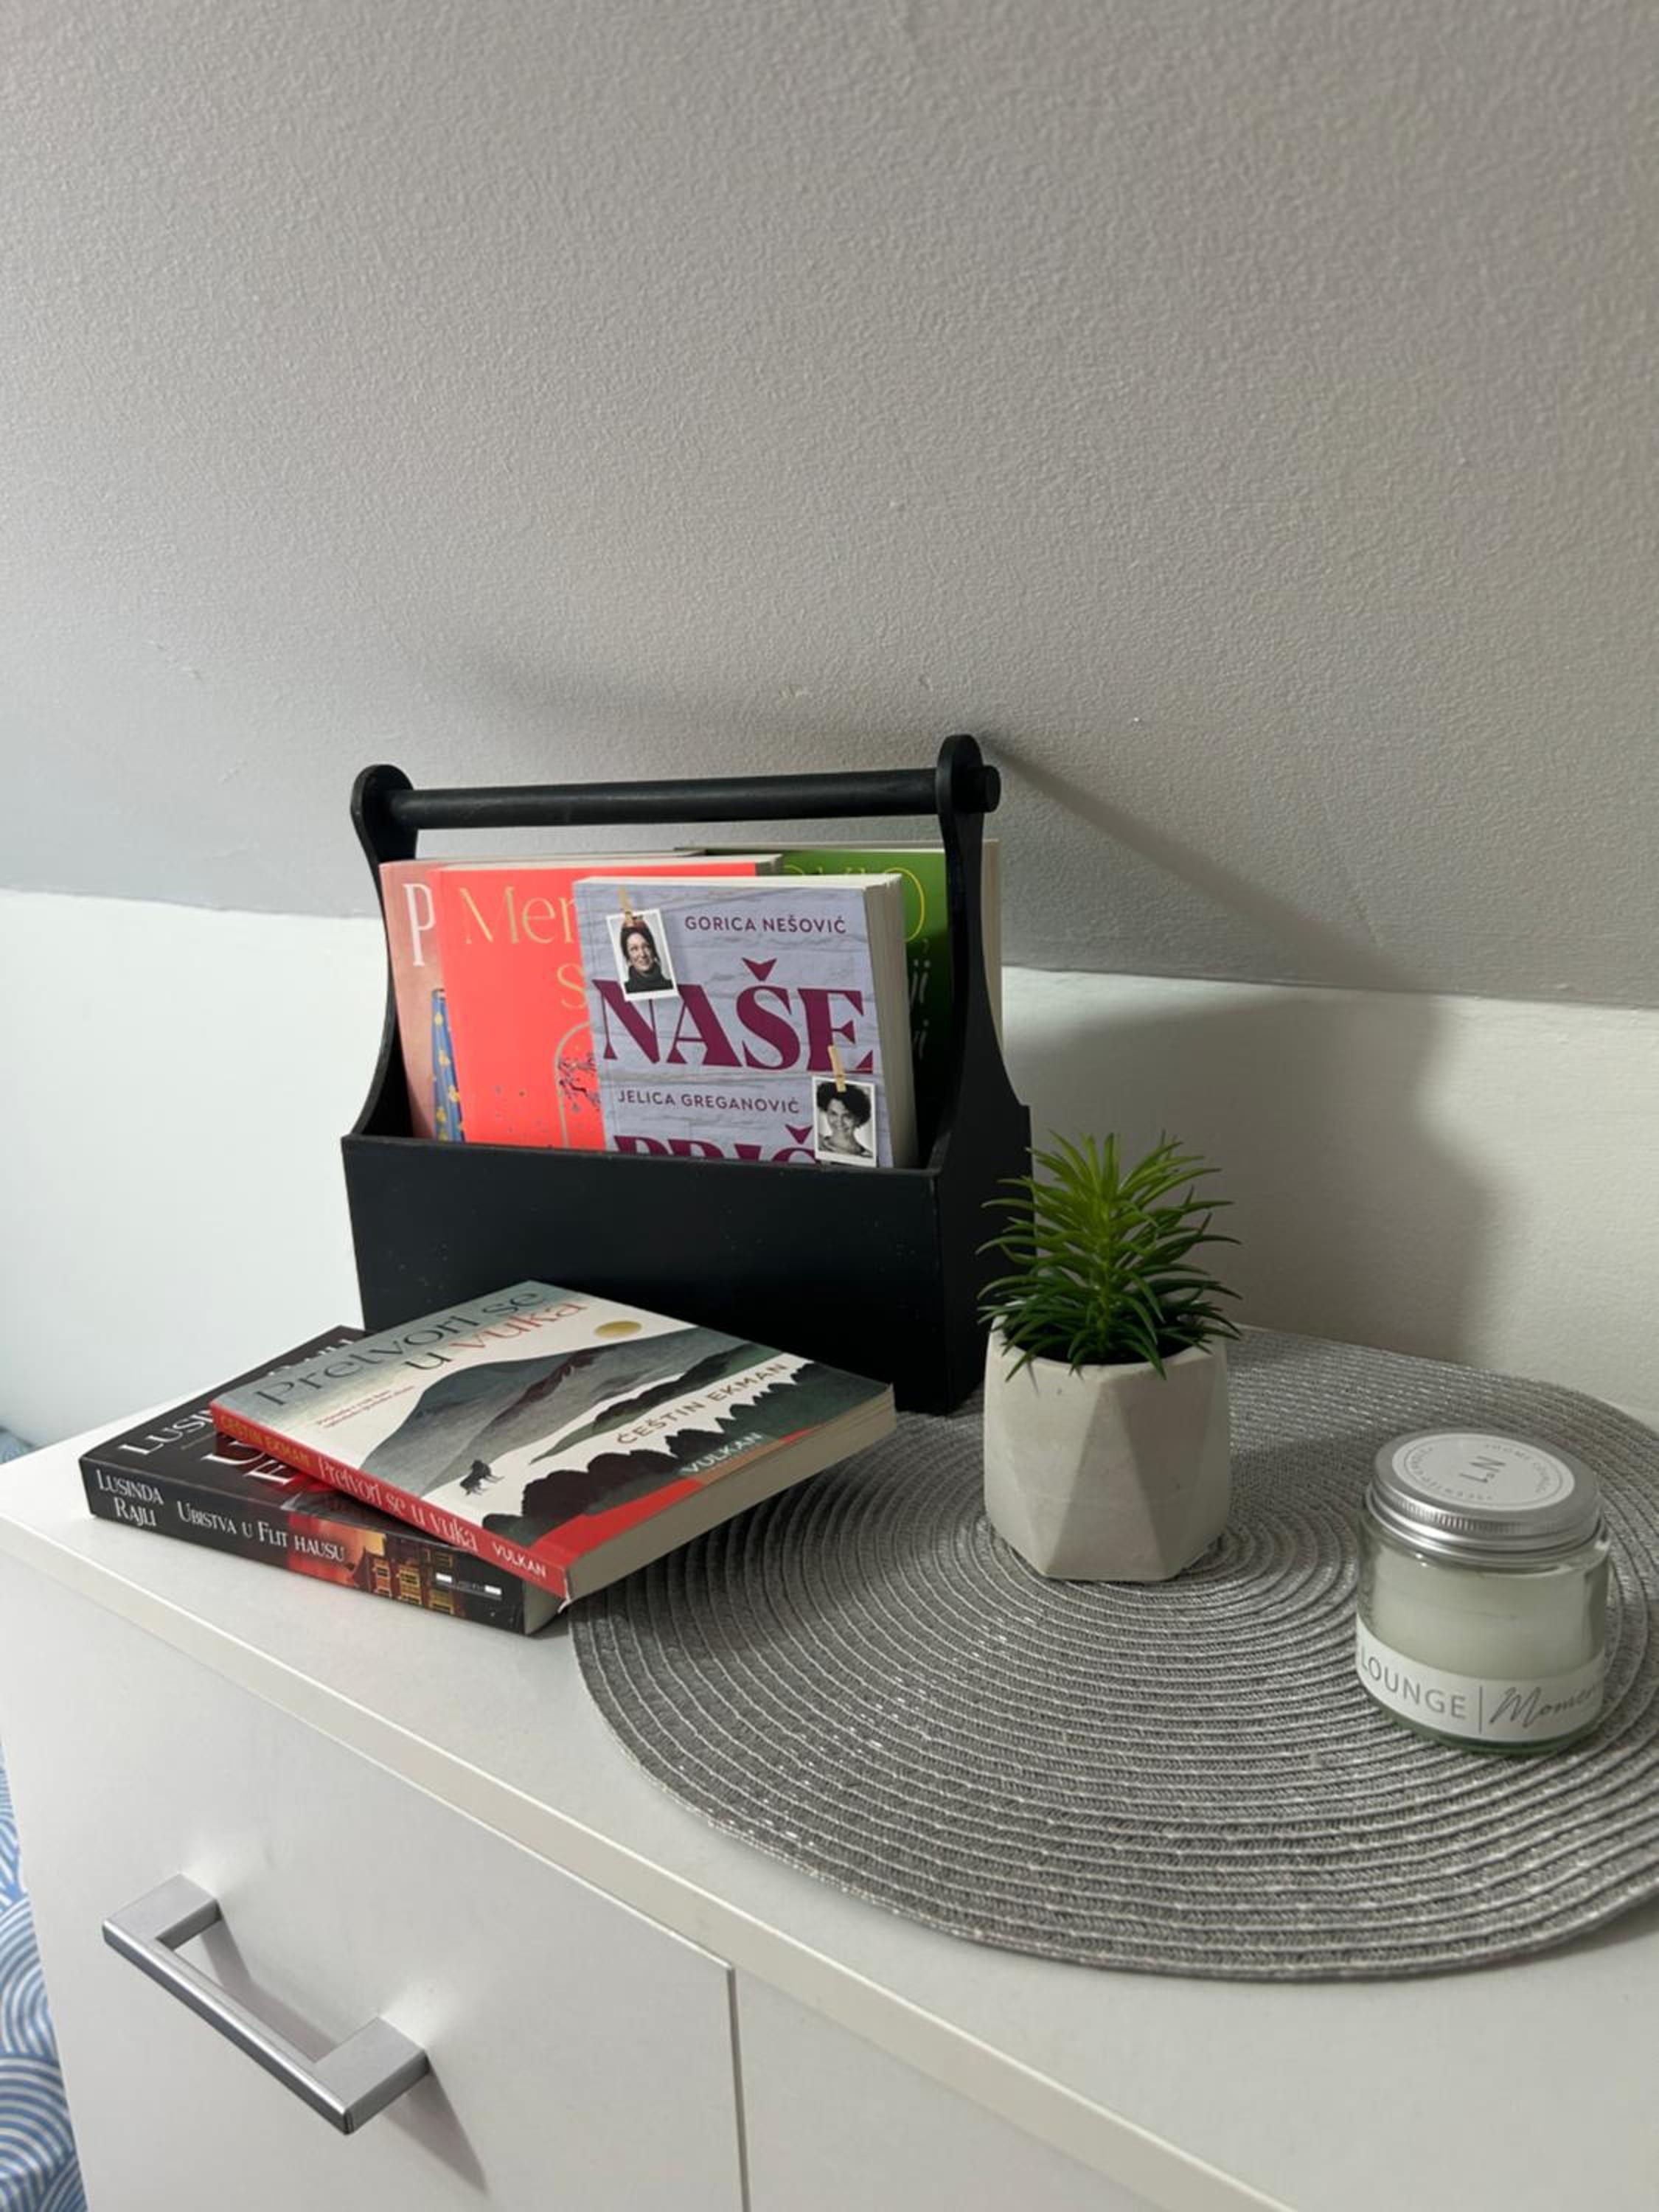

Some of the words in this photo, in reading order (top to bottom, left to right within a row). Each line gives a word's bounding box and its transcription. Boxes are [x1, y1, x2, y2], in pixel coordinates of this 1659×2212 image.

[685, 915, 757, 932] GORICA
[763, 914, 846, 934] NEŠOVIĆ
[591, 957, 873, 1074] NAŠE
[618, 1090, 675, 1106] JELICA
[681, 1093, 800, 1113] GREGANOVIĆ
[481, 1292, 546, 1317] se
[405, 1351, 453, 1371] u
[448, 1302, 588, 1350] vuka
[706, 1363, 788, 1403] EKMAN
[679, 1431, 764, 1474] VULKAN
[96, 1469, 164, 1505] LUSINDA
[114, 1497, 156, 1527] RAJLI
[177, 1500, 237, 1534] UBISTVA
[242, 1521, 253, 1539] U
[258, 1520, 289, 1548] FLIT
[294, 1535, 345, 1562] HAUSU
[386, 1492, 406, 1515] se
[411, 1505, 425, 1527] u
[429, 1512, 479, 1554] vuka
[492, 1542, 546, 1578] VULKAN
[1361, 1649, 1467, 1719] LOUNGE
